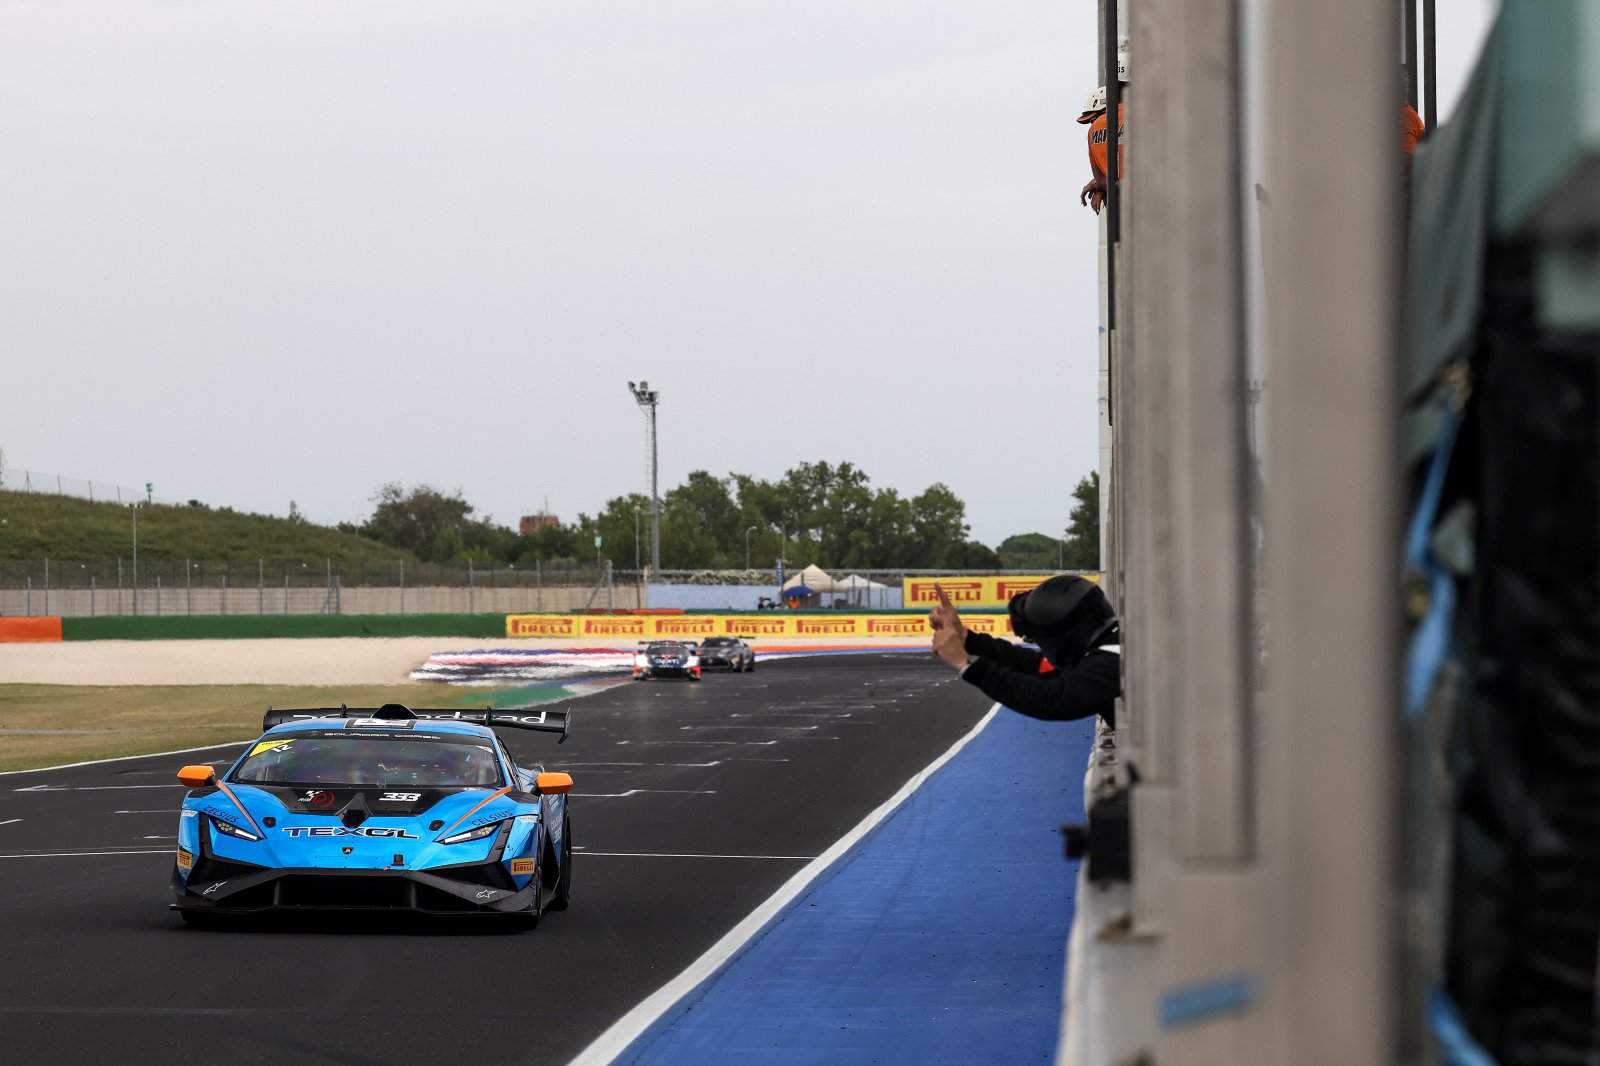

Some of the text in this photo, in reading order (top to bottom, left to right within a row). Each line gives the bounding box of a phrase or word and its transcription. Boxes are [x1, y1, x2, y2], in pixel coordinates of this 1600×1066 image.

[911, 582, 982, 601] PIRELLI
[511, 618, 573, 634] PIRELLI
[584, 619, 644, 634] PIRELLI
[655, 619, 714, 633] PIRELLI
[725, 619, 785, 633] PIRELLI
[796, 619, 855, 633] PIRELLI
[867, 619, 925, 633] PIRELLI
[378, 792, 422, 802] 333
[203, 805, 240, 823] CELSIUS
[471, 810, 513, 826] CELSIUS
[513, 861, 534, 872] PIRELLI
